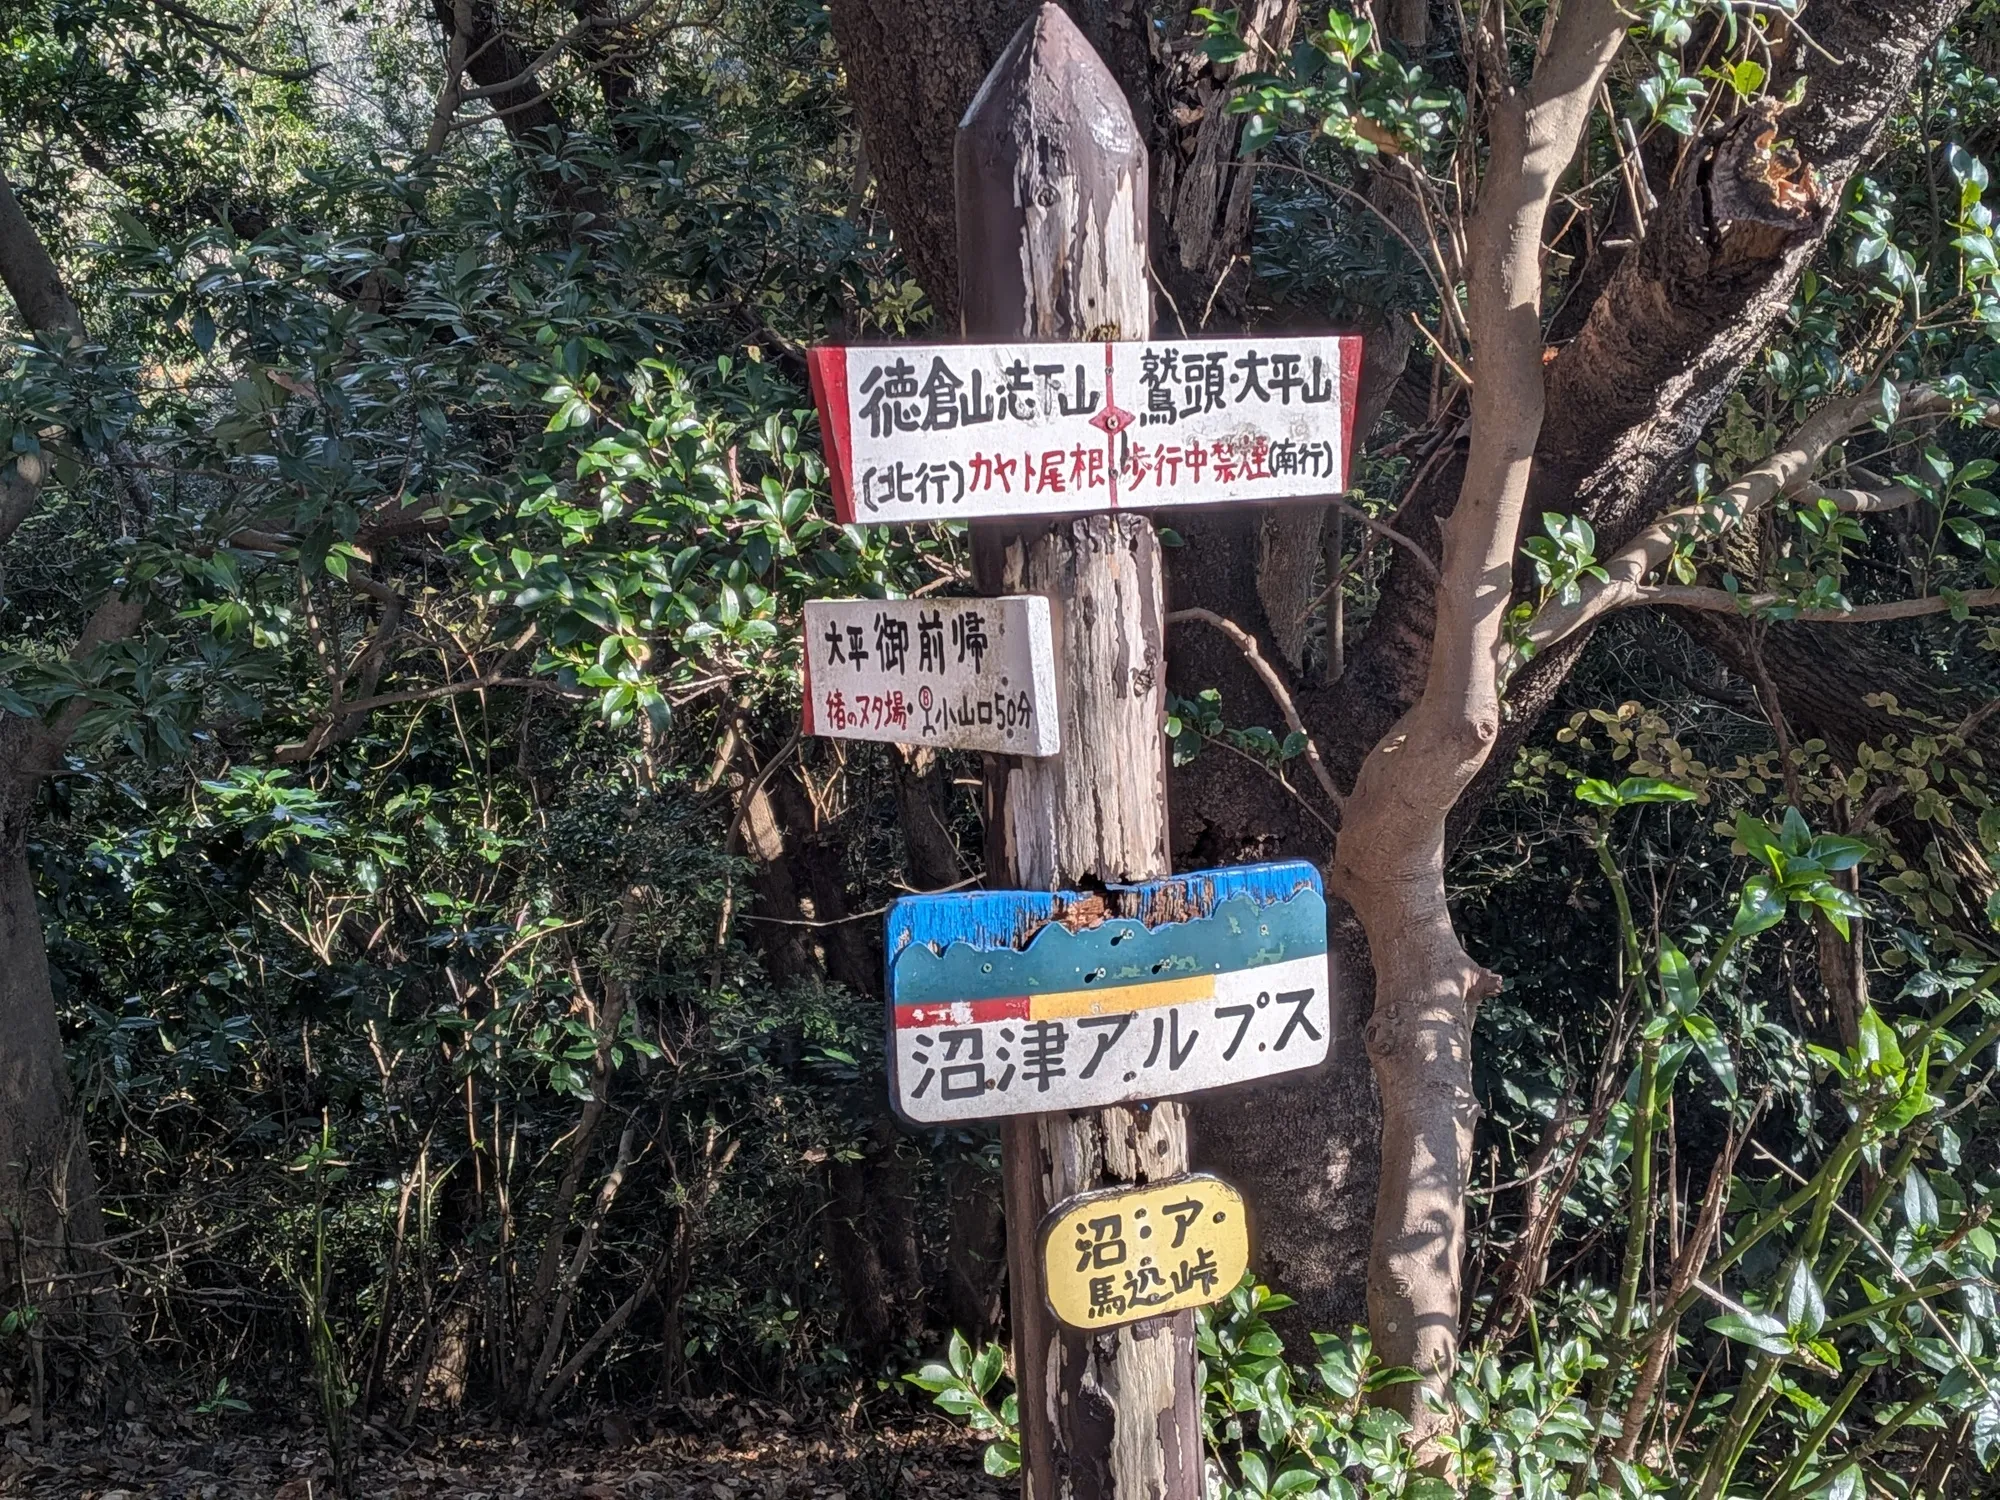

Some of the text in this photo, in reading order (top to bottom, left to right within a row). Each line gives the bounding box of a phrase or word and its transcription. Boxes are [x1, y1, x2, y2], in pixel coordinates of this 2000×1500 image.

[911, 987, 1322, 1100] 沼津アルプス
